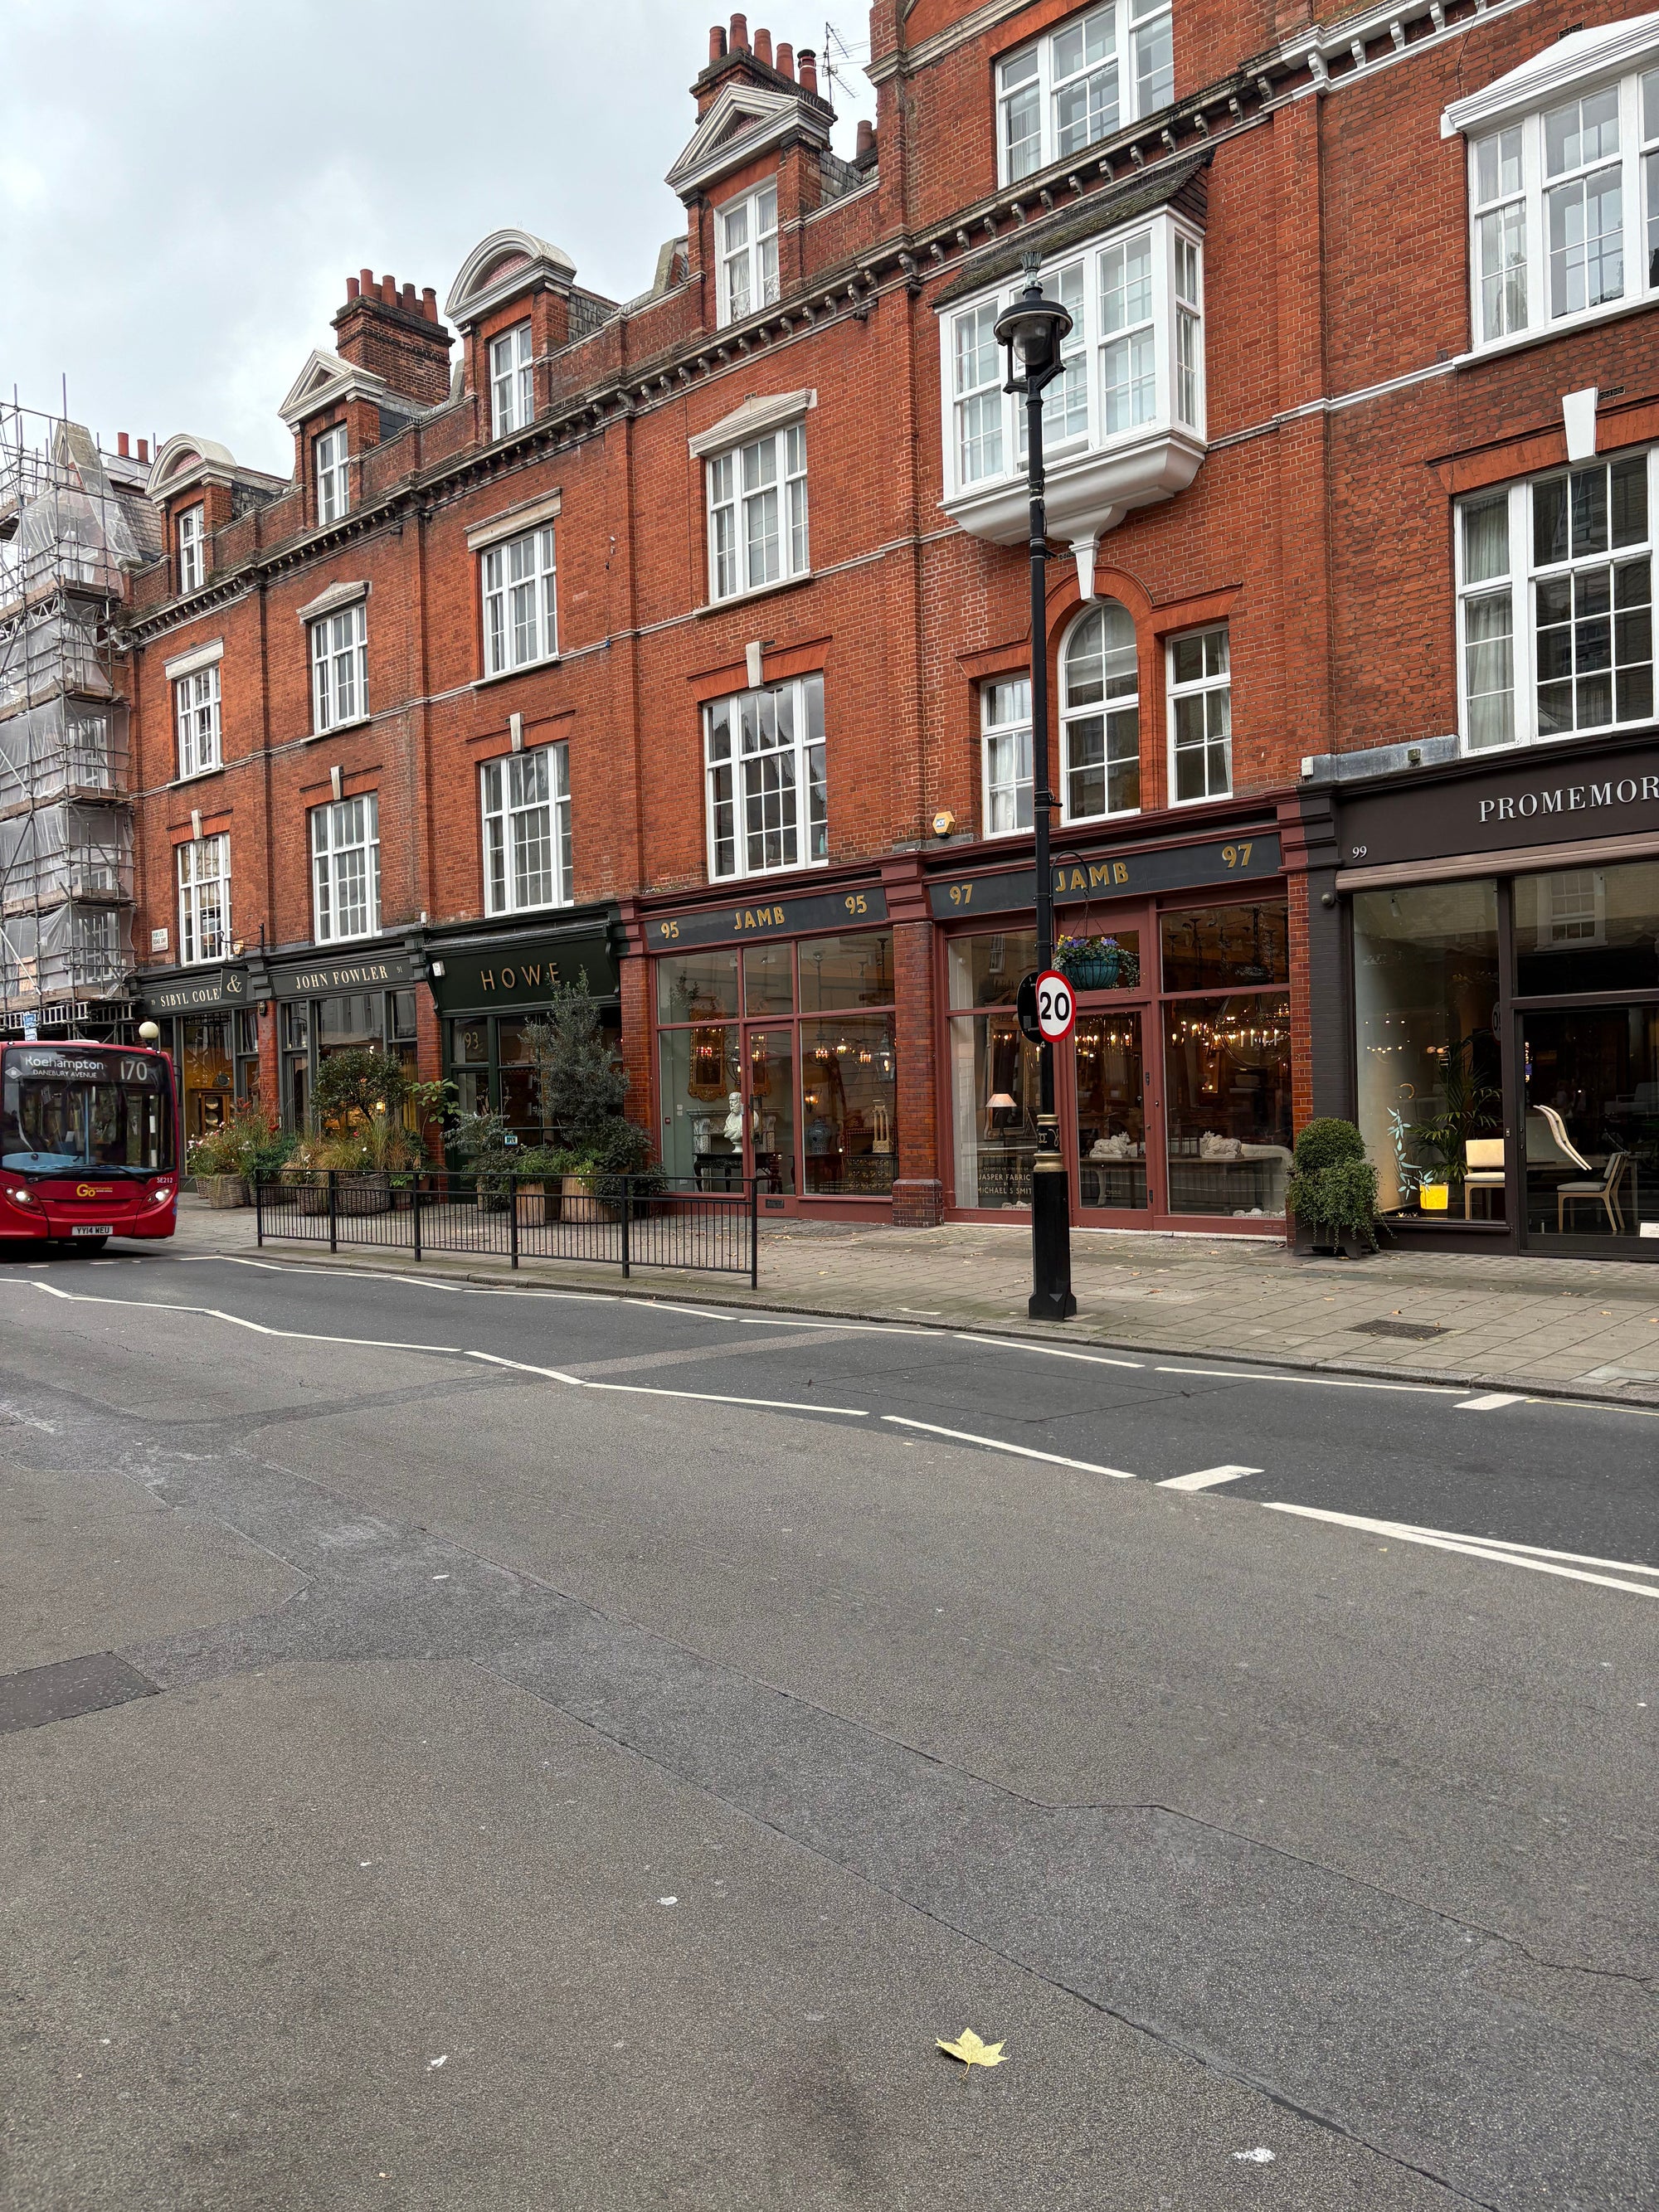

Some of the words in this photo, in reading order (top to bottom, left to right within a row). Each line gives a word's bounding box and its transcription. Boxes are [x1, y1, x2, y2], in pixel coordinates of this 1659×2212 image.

[1479, 775, 1659, 823] PROMEMOR
[1222, 843, 1253, 869] 97
[1352, 845, 1367, 859] 99
[1055, 862, 1129, 893] JAMB
[950, 883, 973, 906] 97
[844, 895, 868, 915] 95
[734, 906, 786, 931] JAMB
[660, 921, 679, 939] 95
[295, 973, 328, 989] JOHN
[333, 965, 388, 984] FOWLER
[396, 965, 403, 974] 91
[480, 962, 561, 991] HOWE
[226, 975, 242, 993] &
[160, 993, 189, 1007] SIBYL
[1040, 992, 1070, 1021] 20
[465, 1032, 479, 1050] 93
[25, 1055, 104, 1071] Roehampton
[120, 1061, 148, 1081] 170
[32, 1069, 69, 1077] DANEBURY
[71, 1070, 97, 1078] AVENUE
[76, 1184, 95, 1197] Go
